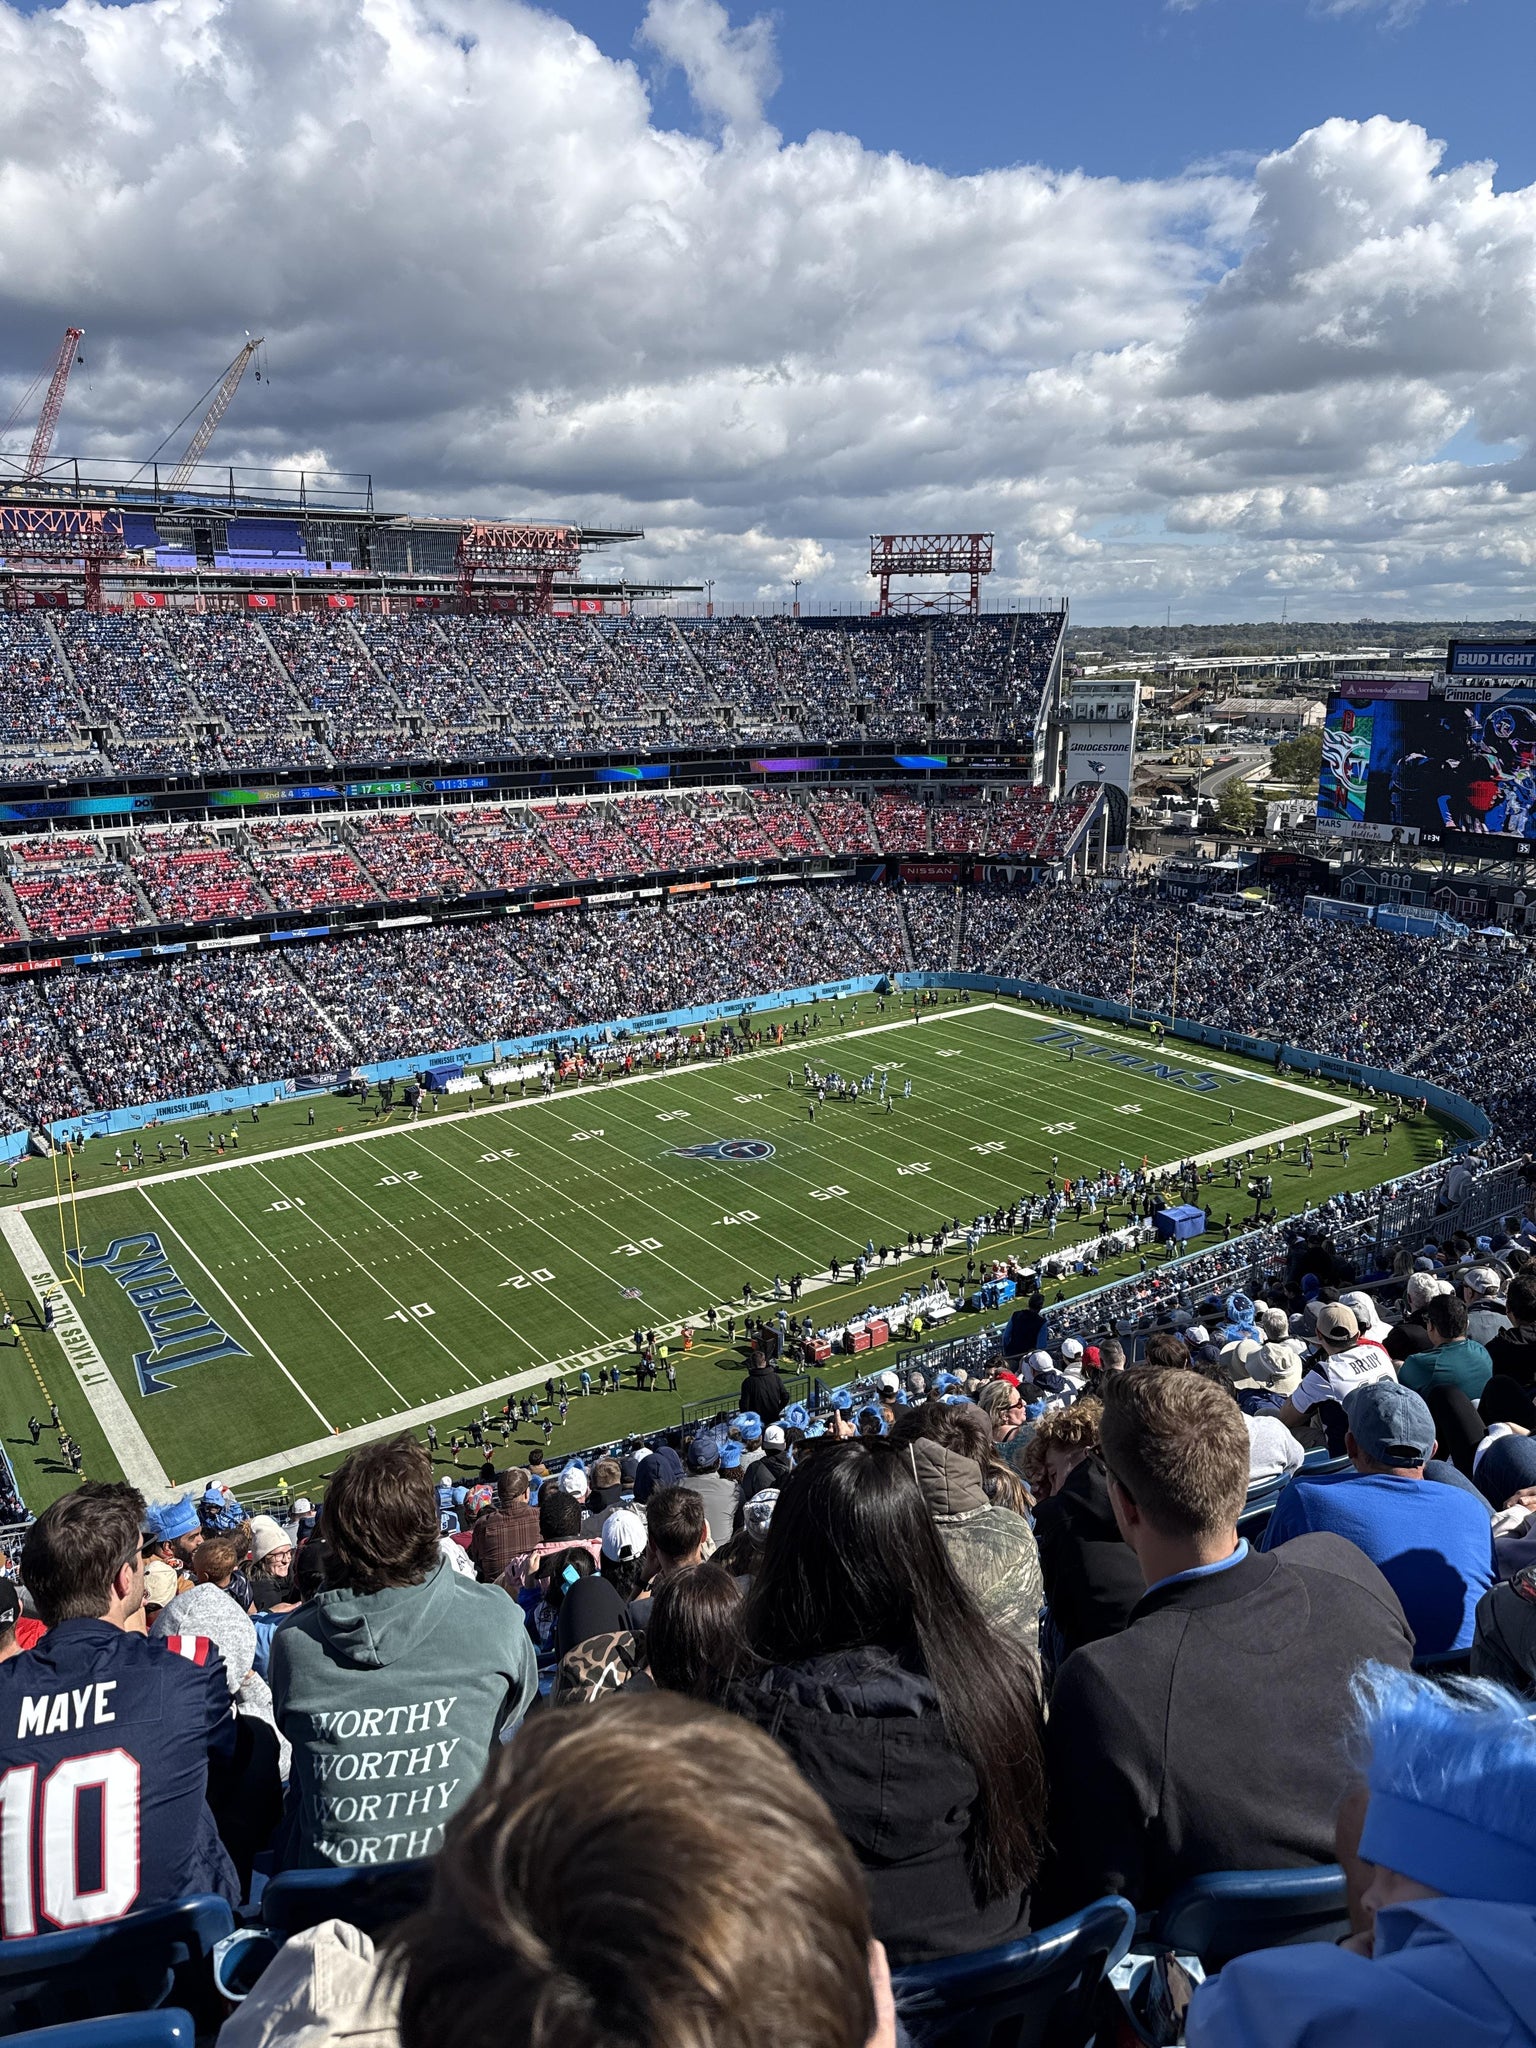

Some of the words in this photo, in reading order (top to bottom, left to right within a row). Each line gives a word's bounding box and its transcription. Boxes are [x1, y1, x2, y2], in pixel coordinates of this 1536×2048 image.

[1457, 653, 1488, 666] BUD
[1490, 653, 1535, 666] LIGHT
[1399, 687, 1420, 695] Thomas
[1446, 688, 1492, 701] Pinnacle
[1070, 742, 1131, 752] BRIDGESTONE
[361, 785, 372, 794] 17
[390, 783, 401, 792] 13
[441, 779, 468, 790] 11:35
[264, 791, 280, 800] 2nd
[1317, 819, 1342, 829] MARS
[907, 867, 953, 876] NISSAN
[429, 1055, 456, 1067] TENNESSEE
[1031, 1026, 1246, 1093] TITANS
[1165, 1048, 1213, 1066] CATCH
[155, 1103, 190, 1117] TENNESSEE
[655, 1109, 692, 1122] 50
[1112, 1103, 1143, 1115] 10
[573, 1128, 606, 1142] 40
[1040, 1121, 1077, 1135] 20
[968, 1140, 1004, 1155] 30
[480, 1148, 521, 1163] 30
[896, 1161, 931, 1176] 40
[380, 1170, 424, 1186] 20
[808, 1184, 850, 1201] 50
[271, 1197, 307, 1211] 10
[721, 1209, 762, 1226] 40
[617, 1237, 664, 1257] 30
[31, 1272, 56, 1288] US
[506, 1267, 556, 1290] 20
[53, 1303, 77, 1326] ALL
[62, 1231, 255, 1397] TITANS
[394, 1302, 437, 1323] 10
[61, 1327, 99, 1370] TAKES
[1348, 1352, 1382, 1376] BRADY
[81, 1371, 109, 1387] IT
[17, 1680, 117, 1740] MAYE
[310, 1696, 458, 1739] WORTHY
[311, 1737, 460, 1782] WORTHY
[312, 1778, 461, 1823] WORTHY
[0, 1746, 141, 1940] 10
